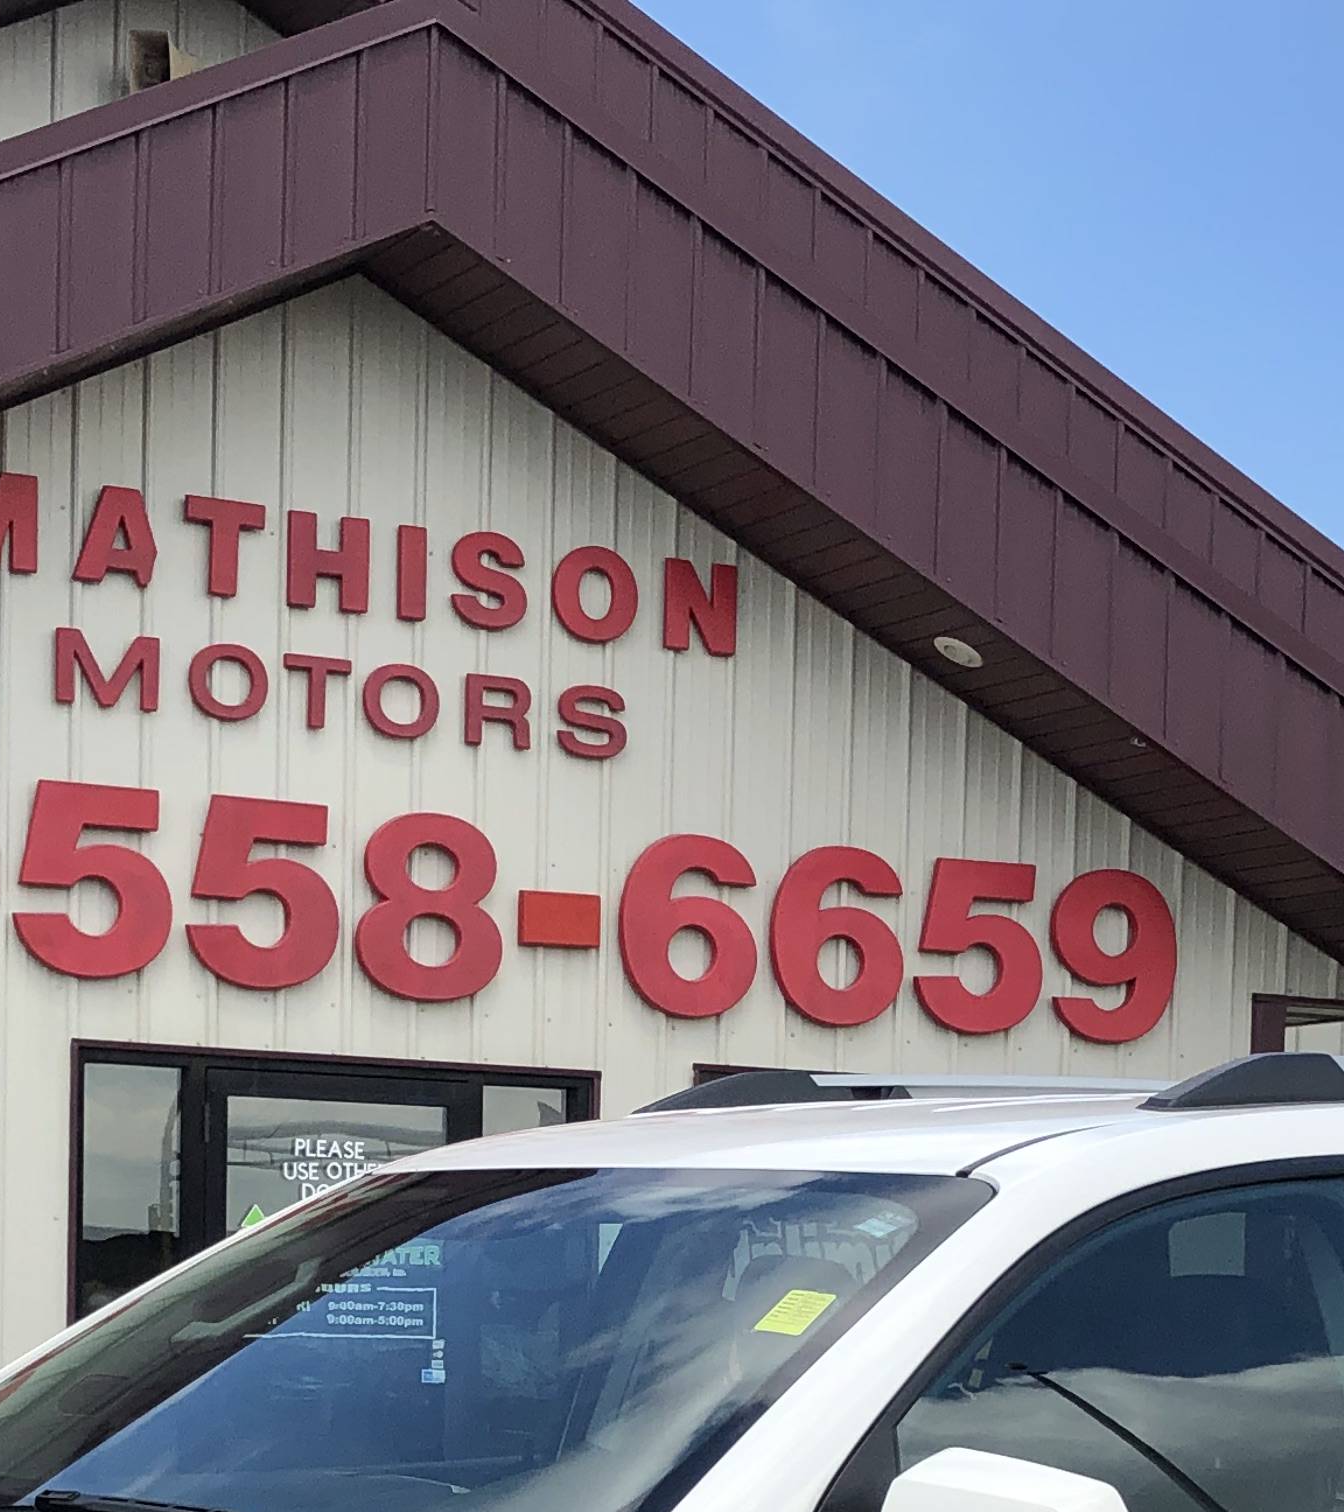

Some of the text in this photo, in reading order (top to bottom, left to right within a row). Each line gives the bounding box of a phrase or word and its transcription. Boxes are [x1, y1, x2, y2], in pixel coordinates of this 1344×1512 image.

[55, 628, 628, 760] MOTORS
[294, 1137, 366, 1160] PLEASE
[282, 1161, 320, 1181] USE
